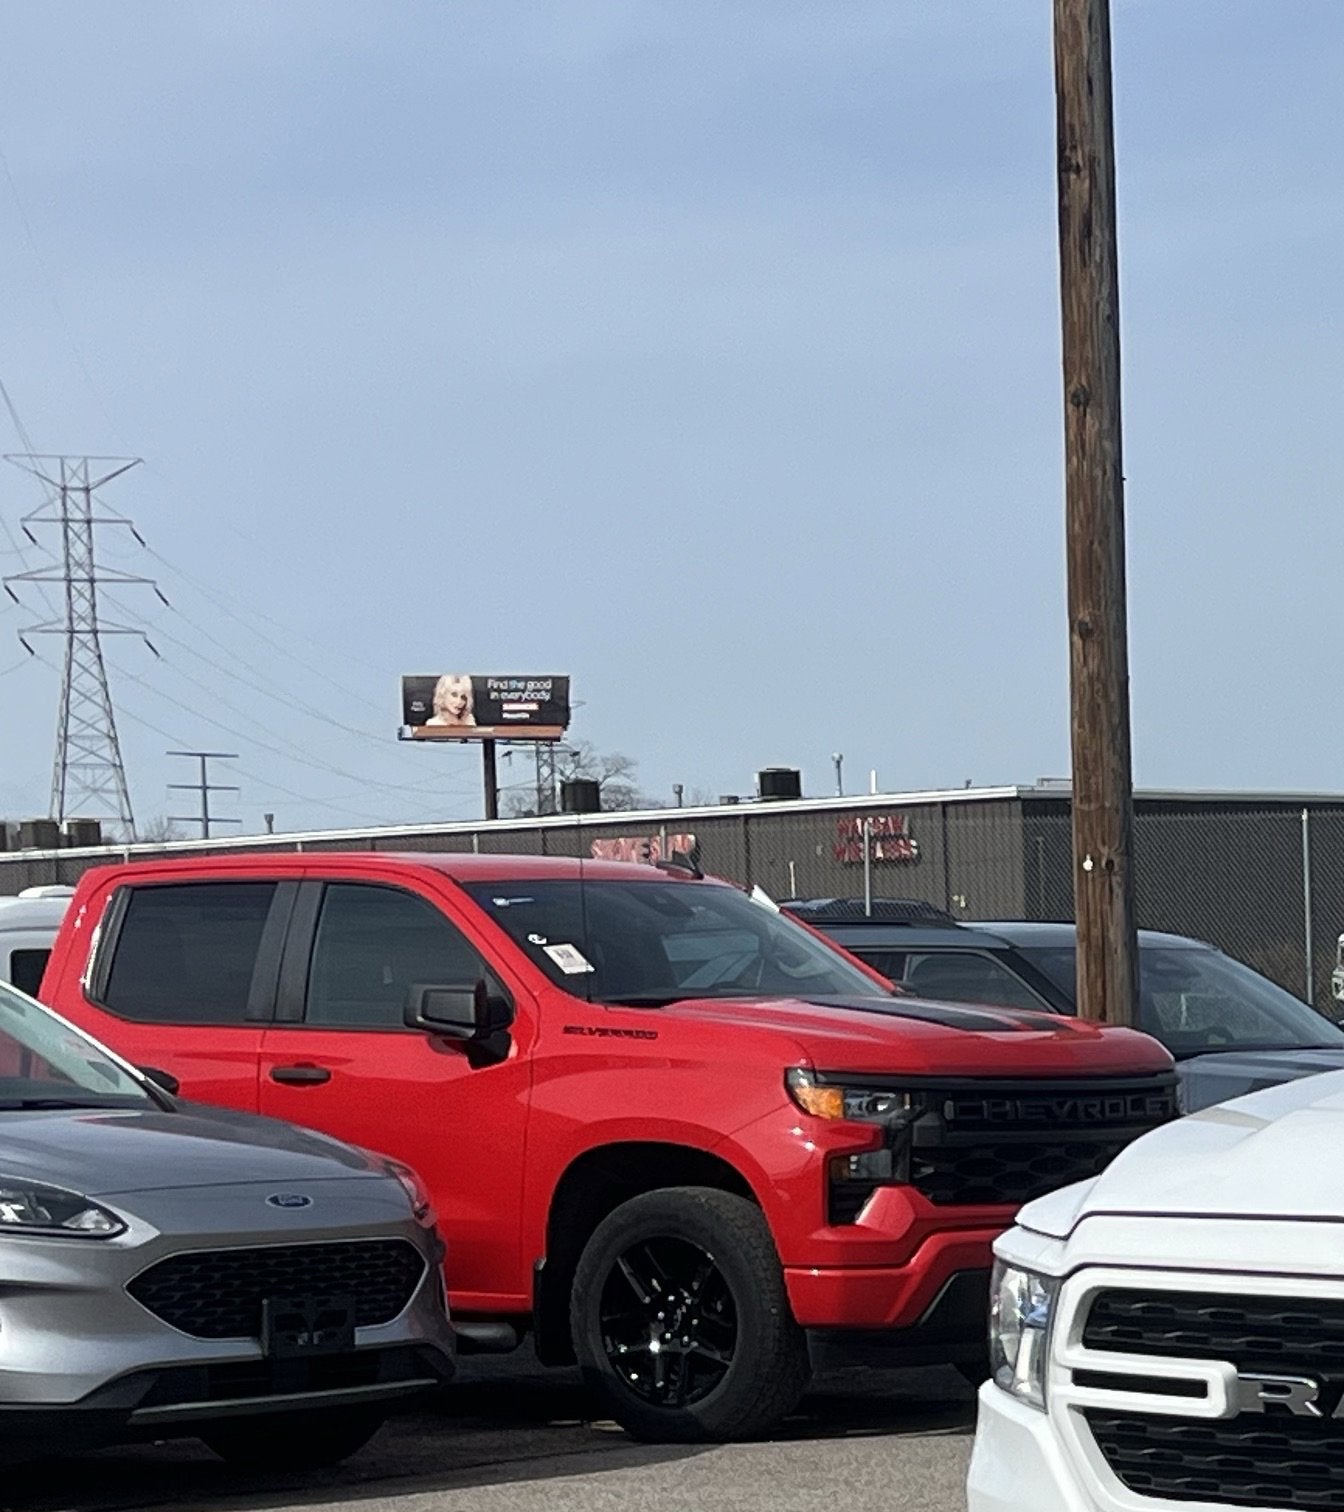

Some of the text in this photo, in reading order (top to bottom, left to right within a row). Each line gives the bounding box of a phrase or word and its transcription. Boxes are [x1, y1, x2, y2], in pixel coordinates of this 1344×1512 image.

[487, 679, 552, 691] Find the good
